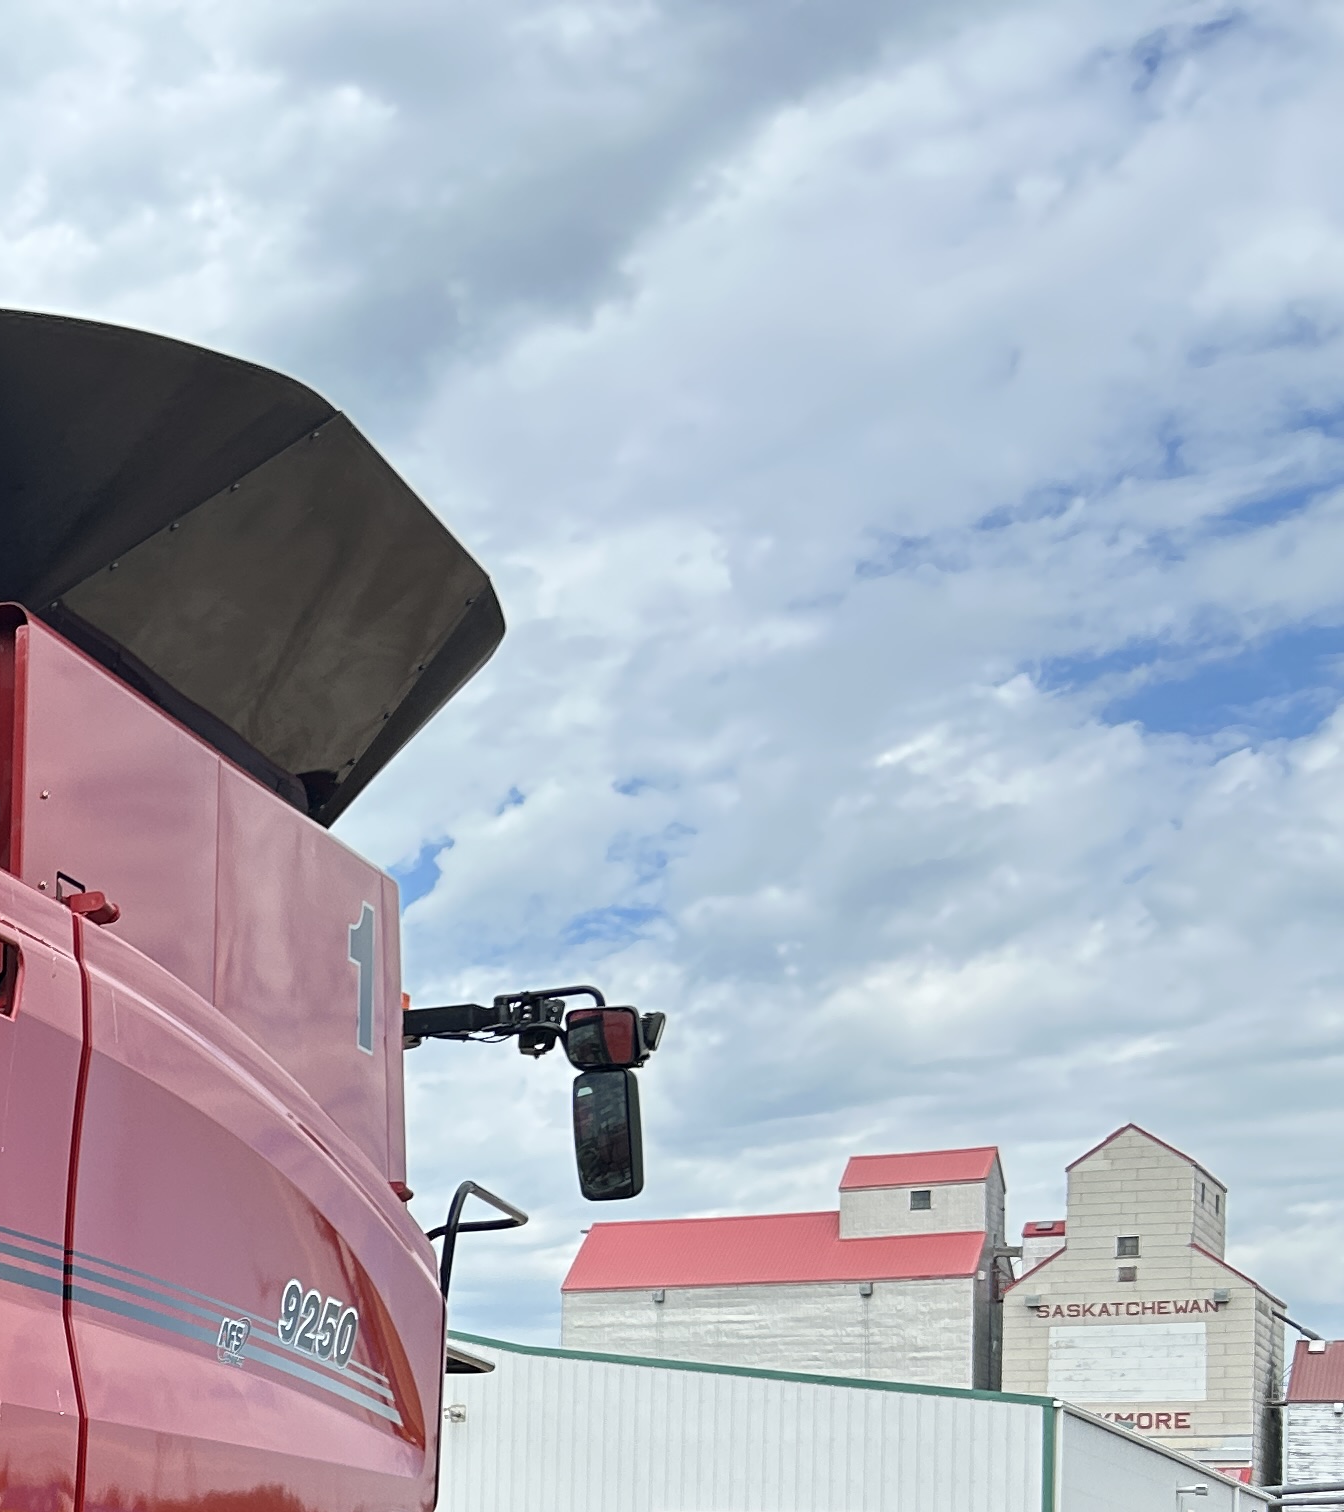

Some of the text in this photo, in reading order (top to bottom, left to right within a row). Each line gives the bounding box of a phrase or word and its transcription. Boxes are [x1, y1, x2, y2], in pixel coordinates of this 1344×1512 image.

[348, 900, 376, 1056] 1
[277, 1278, 360, 1371] 9250
[1035, 1298, 1221, 1320] SASKATCHEWAN
